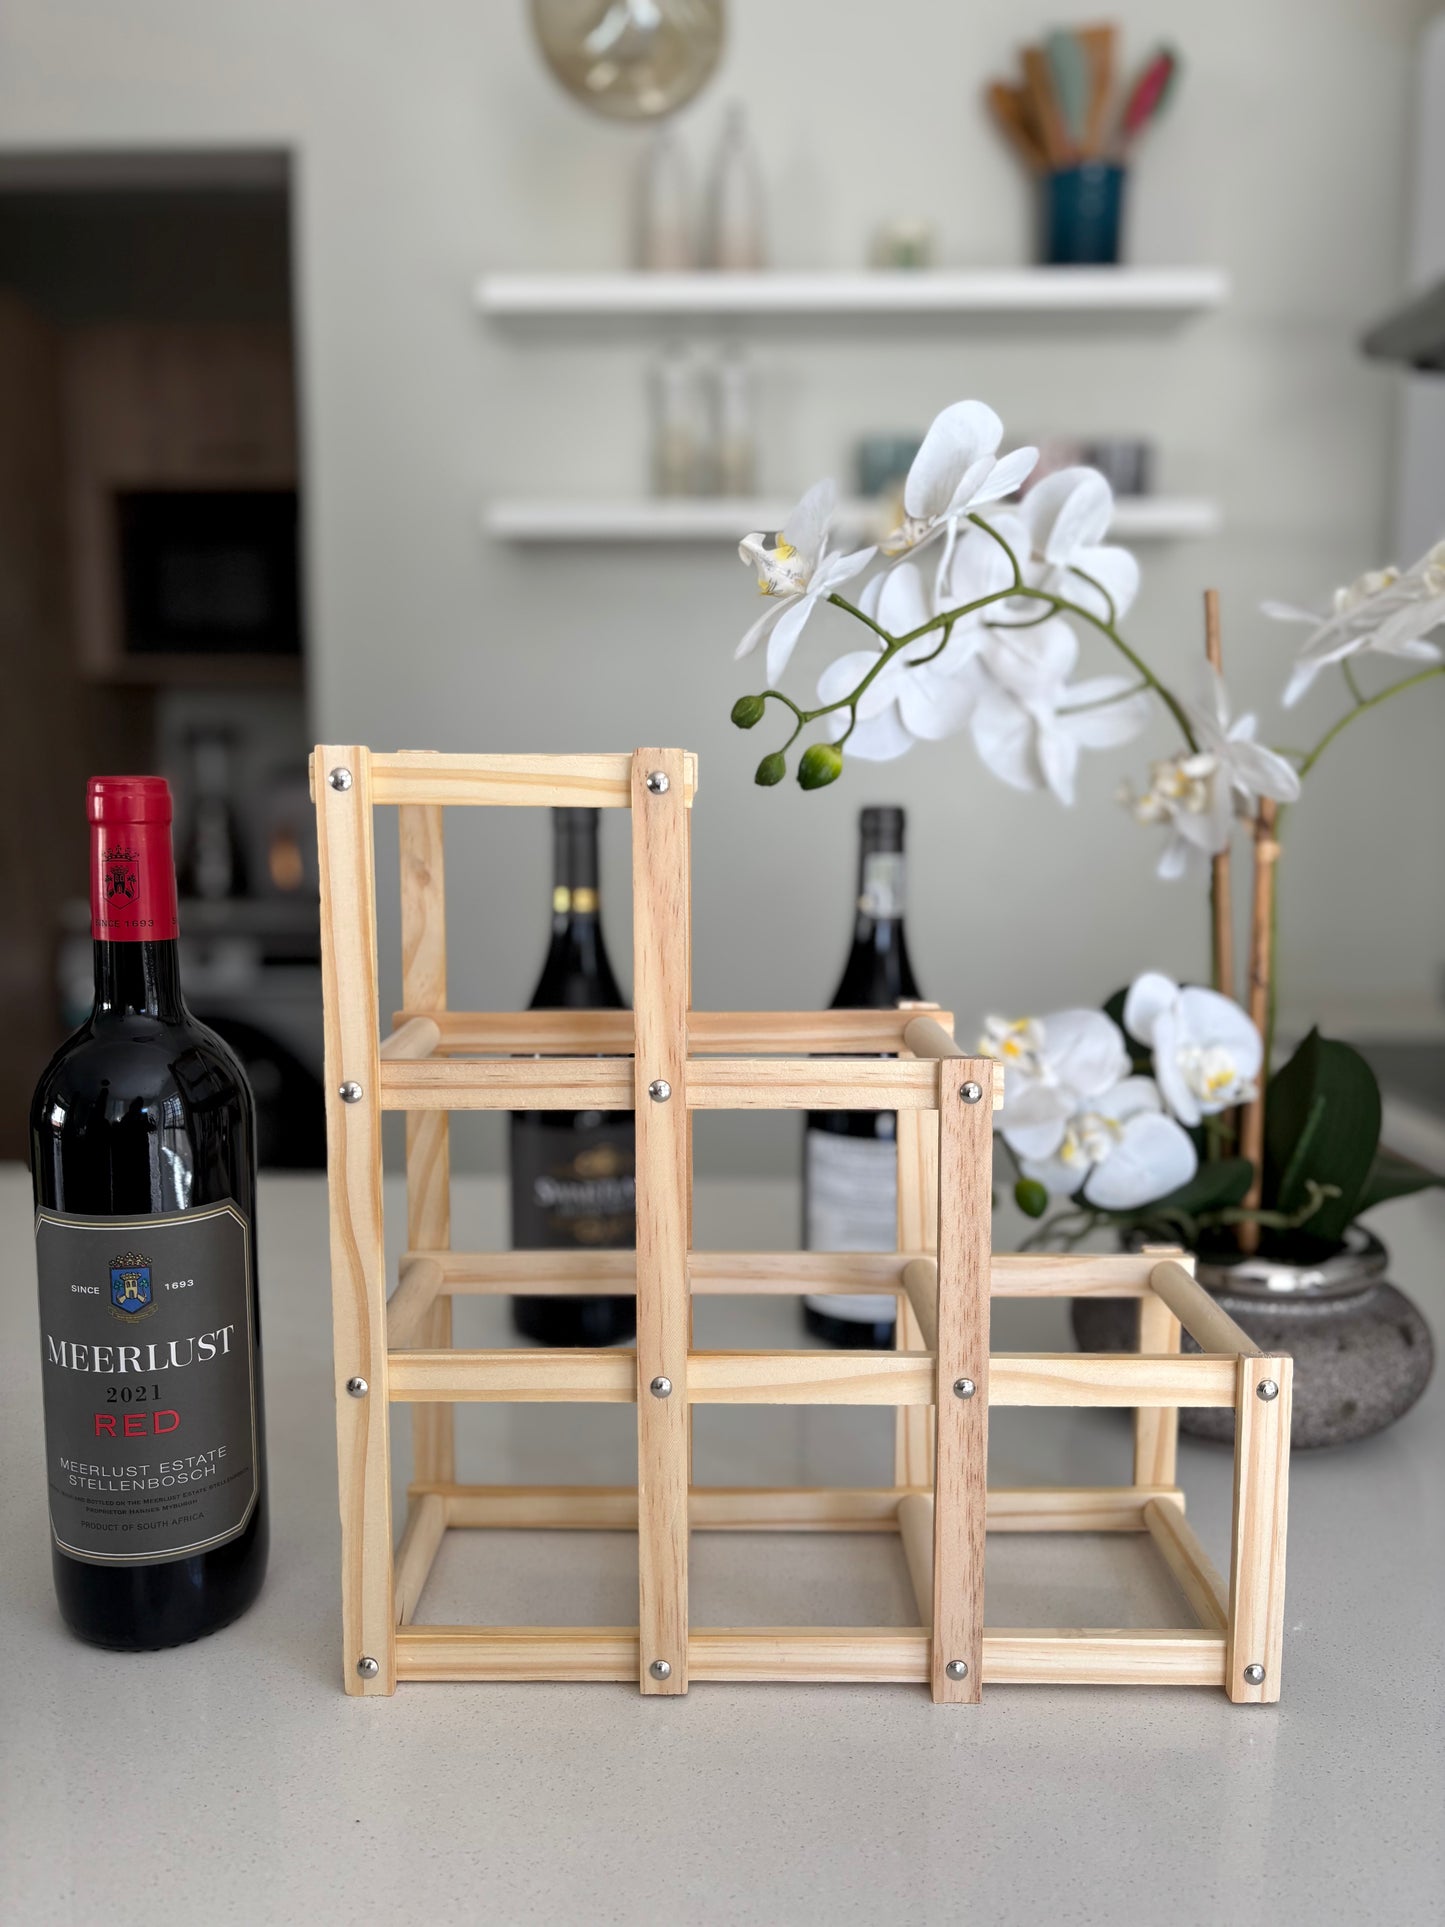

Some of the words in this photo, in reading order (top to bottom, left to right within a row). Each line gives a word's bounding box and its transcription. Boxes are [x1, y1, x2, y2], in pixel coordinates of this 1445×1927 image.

[125, 918, 154, 928] 1693
[71, 1284, 100, 1295] SINCE
[164, 1279, 195, 1291] 1693
[47, 1324, 235, 1374] MEERLUST
[106, 1384, 162, 1404] 2021
[94, 1409, 182, 1438] RED
[60, 1457, 151, 1478] MEERLUST
[159, 1445, 228, 1474] ESTATE
[68, 1464, 217, 1492] STELLENBOSCH
[81, 1520, 119, 1532] PRODUCT
[121, 1523, 134, 1532] OF
[137, 1519, 169, 1531] SOUTH
[171, 1512, 205, 1526] AFRICA
